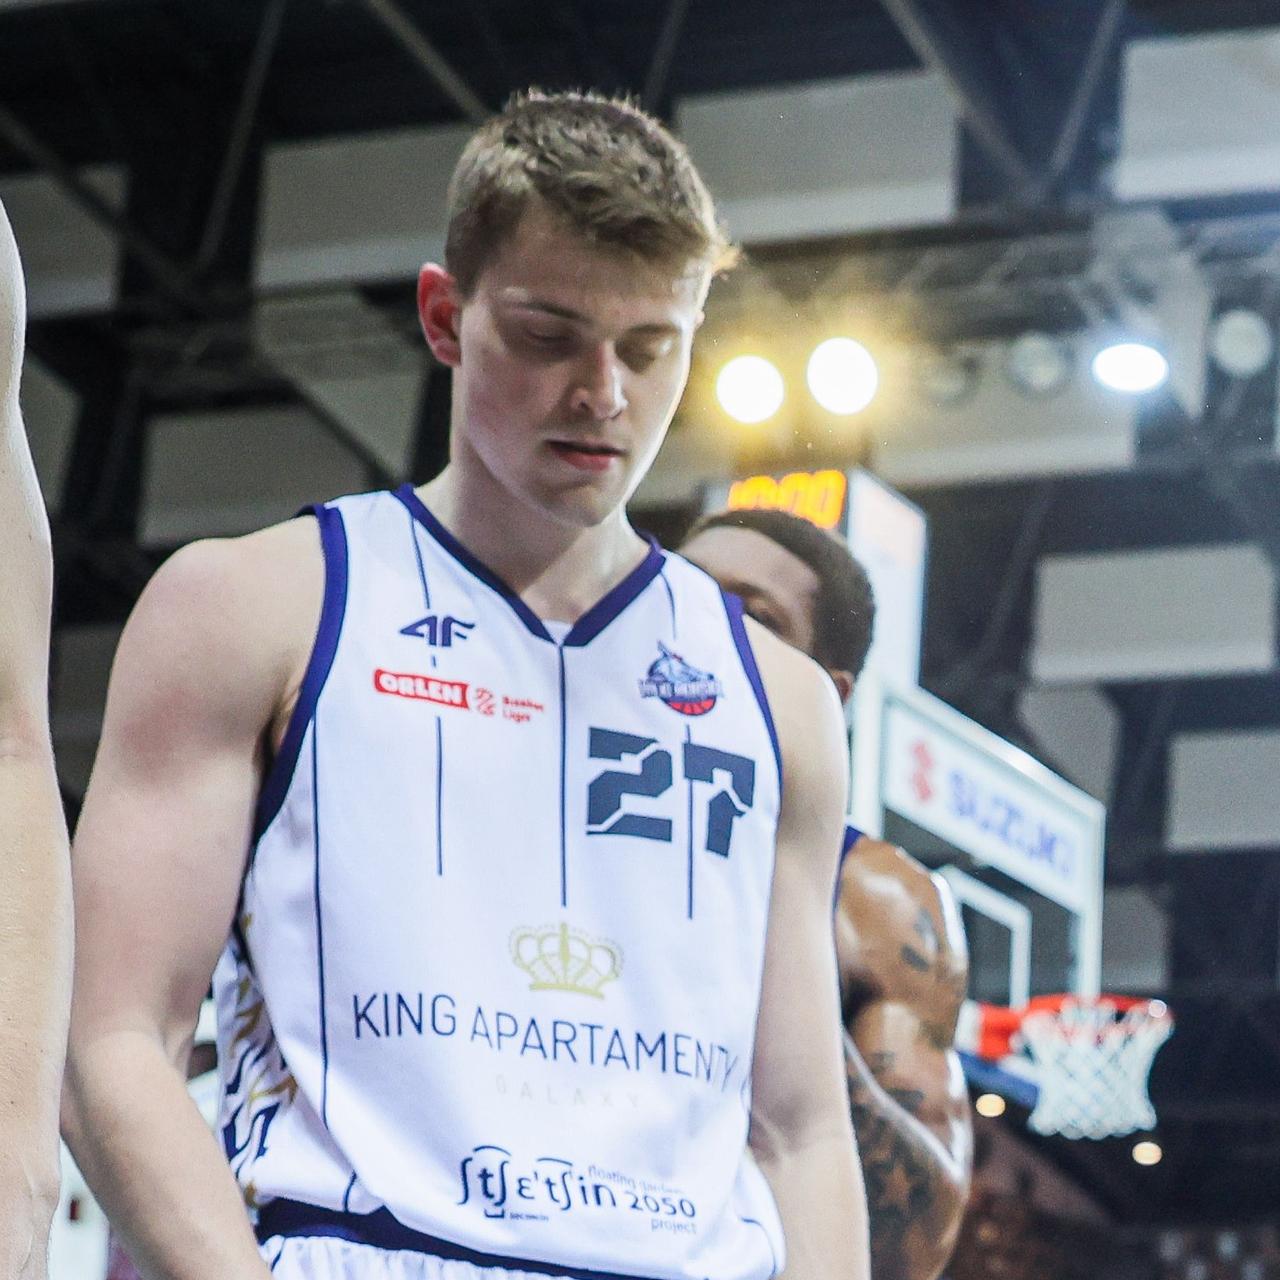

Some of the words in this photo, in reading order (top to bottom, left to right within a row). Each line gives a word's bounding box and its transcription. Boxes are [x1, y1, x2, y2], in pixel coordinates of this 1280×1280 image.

[399, 615, 476, 647] 4F
[378, 673, 464, 704] ORLEN
[586, 726, 756, 858] 27
[353, 992, 456, 1040] KING
[624, 1190, 697, 1219] 2050
